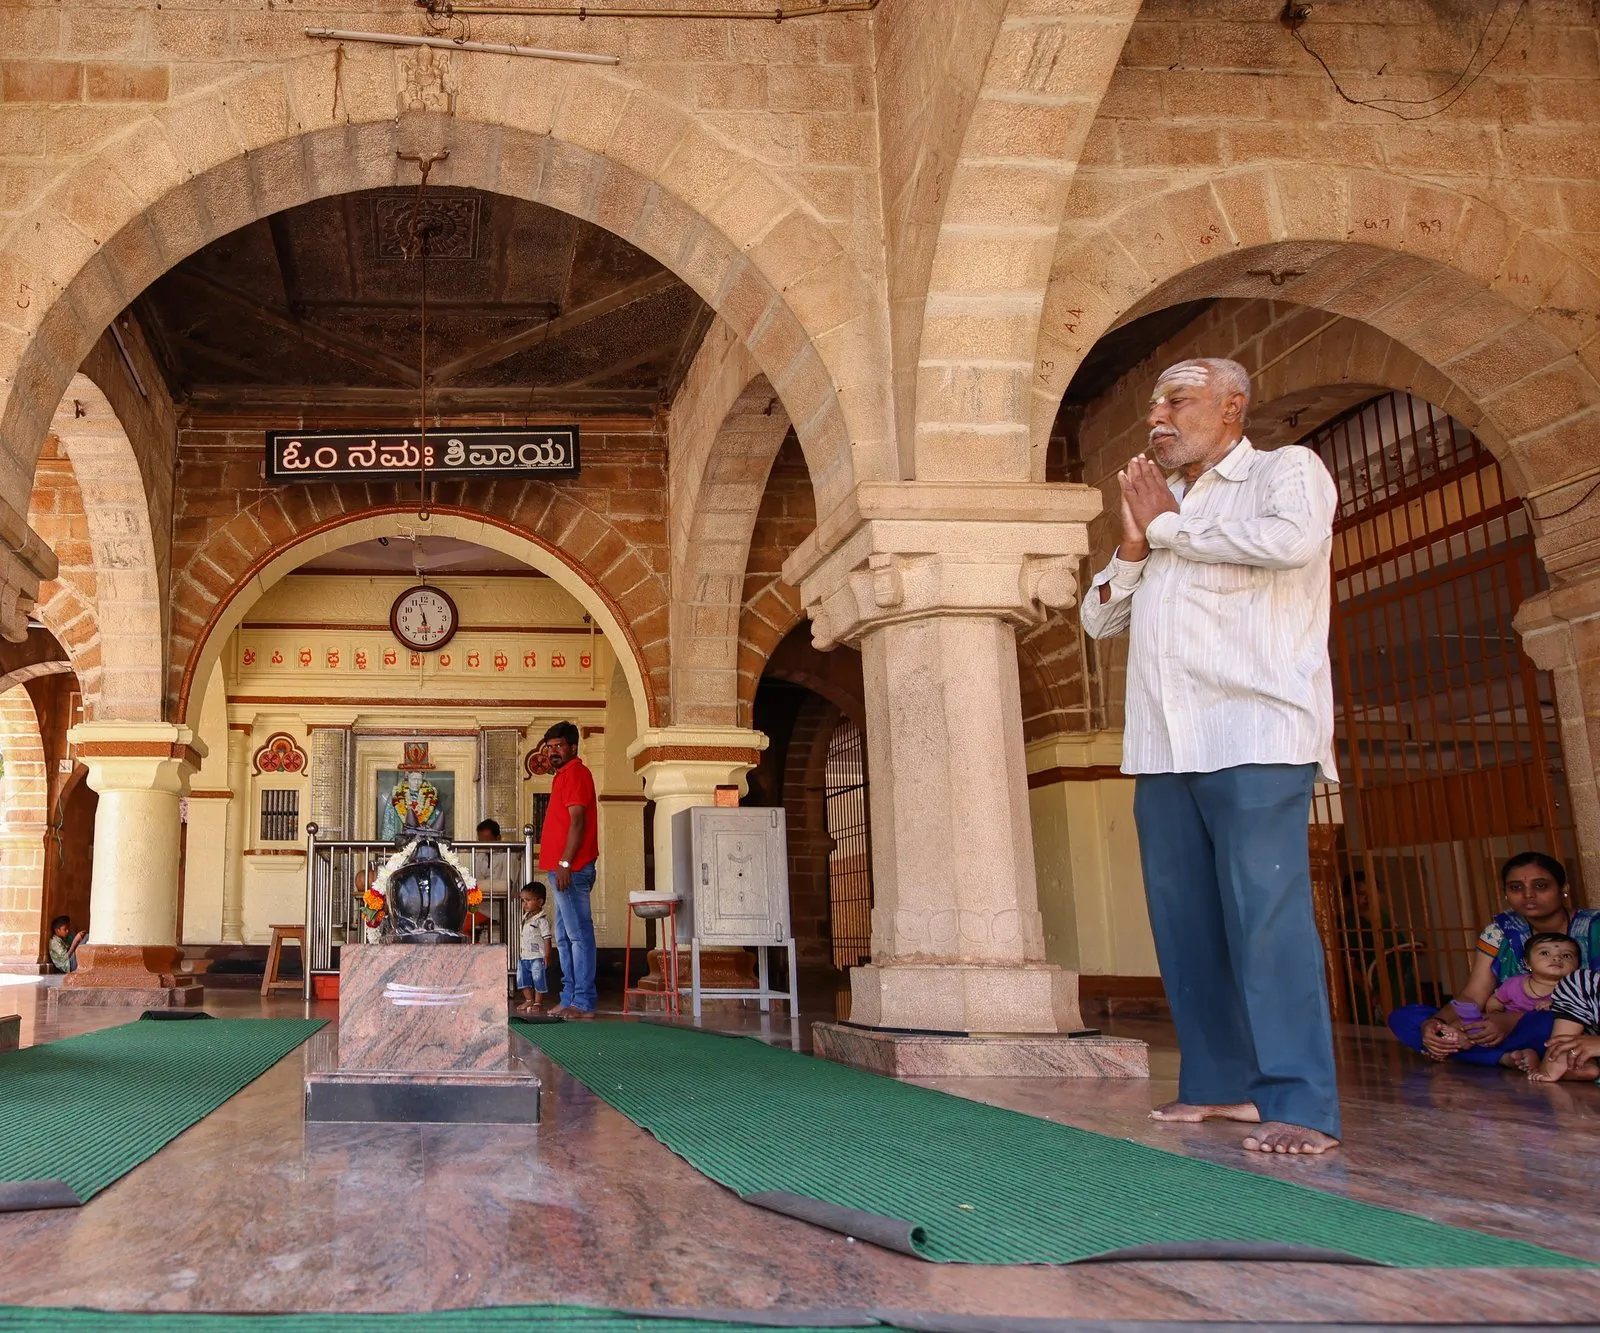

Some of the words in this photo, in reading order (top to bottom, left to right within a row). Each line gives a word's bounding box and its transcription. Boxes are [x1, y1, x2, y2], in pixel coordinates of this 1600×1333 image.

[281, 440, 338, 469] ಓಂ
[347, 439, 435, 468] ನಮಃ
[443, 437, 565, 467] ಶಿವಾಯ
